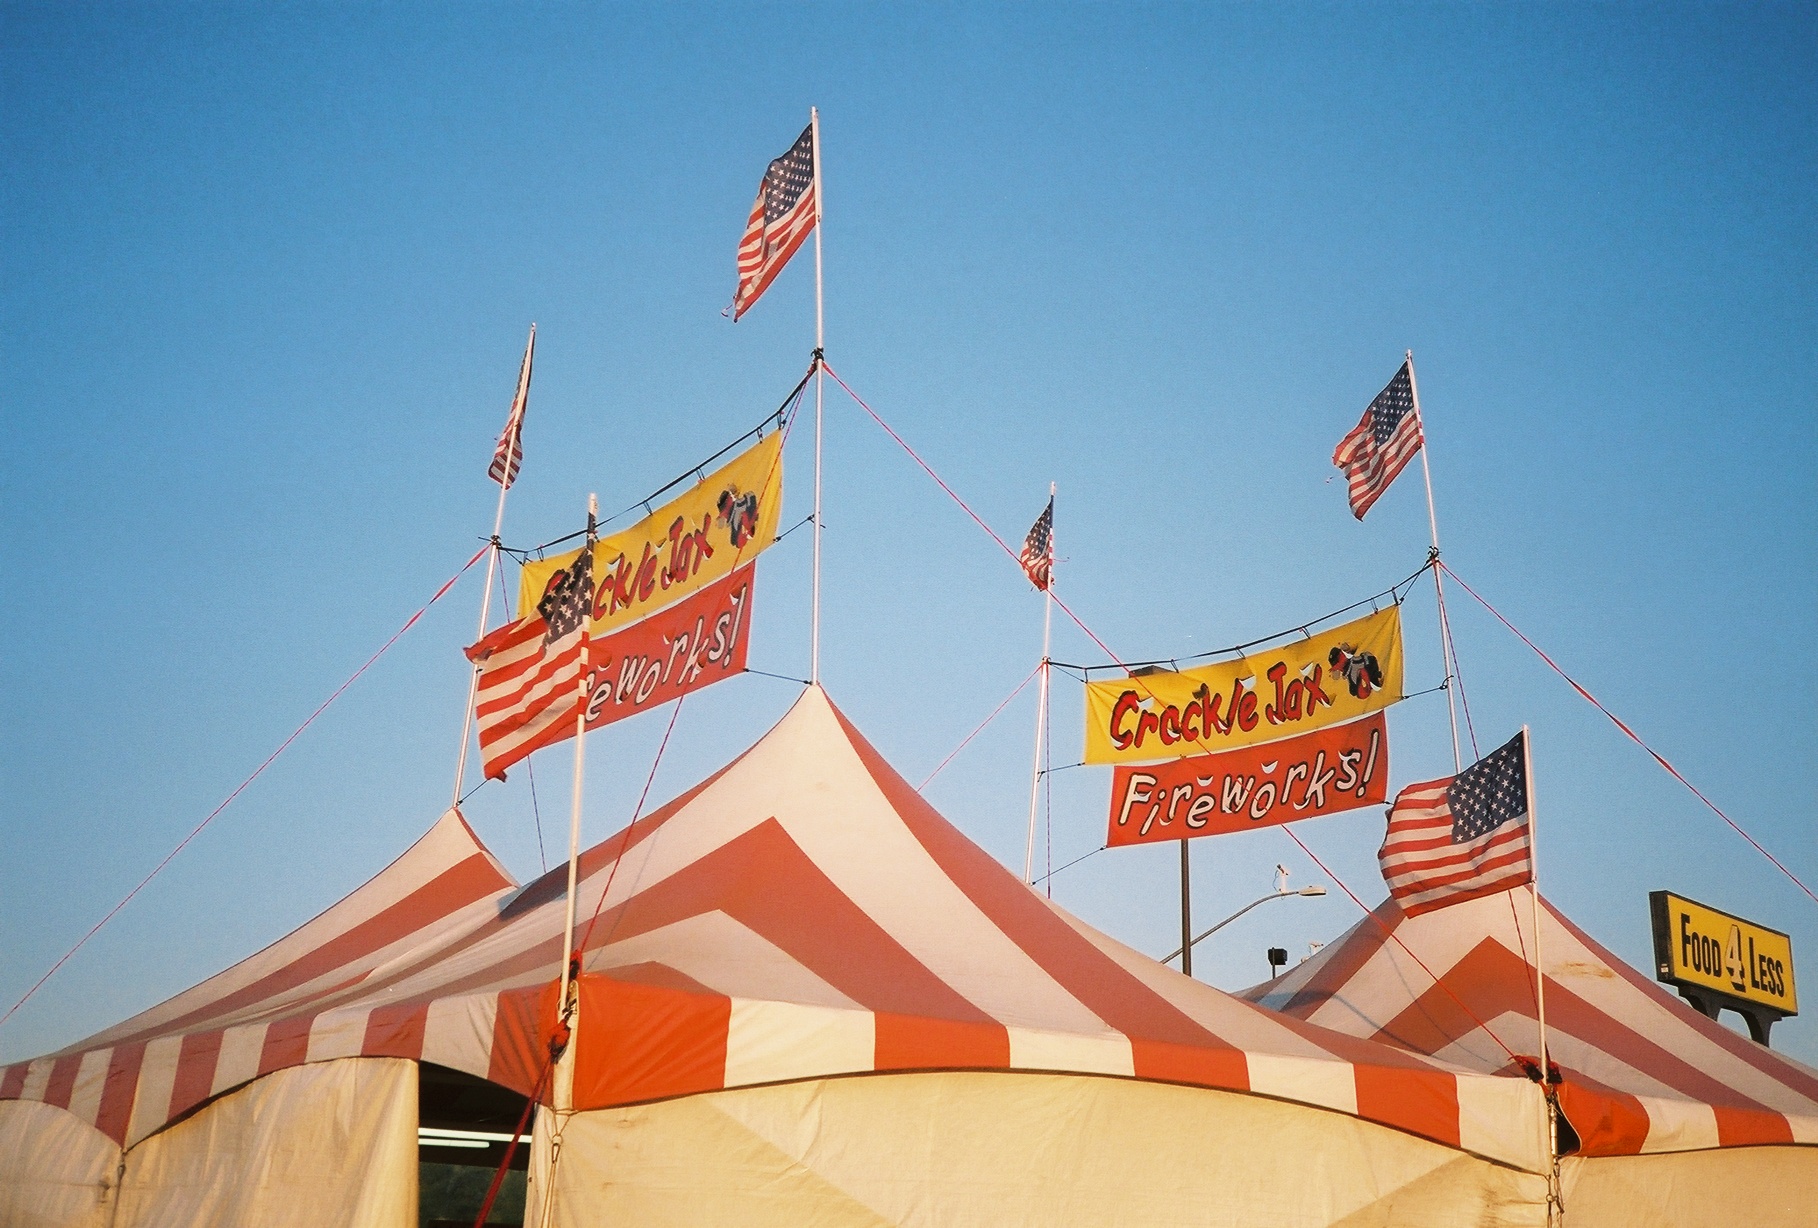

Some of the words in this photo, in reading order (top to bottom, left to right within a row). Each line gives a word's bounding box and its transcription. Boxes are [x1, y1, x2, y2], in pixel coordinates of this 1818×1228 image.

[543, 542, 656, 622] ckle
[661, 513, 714, 586] Jax
[1110, 678, 1259, 750] Crackle
[1265, 661, 1331, 725] Jax
[1681, 913, 1722, 977] FOOD
[1725, 924, 1746, 993] 4
[1749, 937, 1784, 998] LESS
